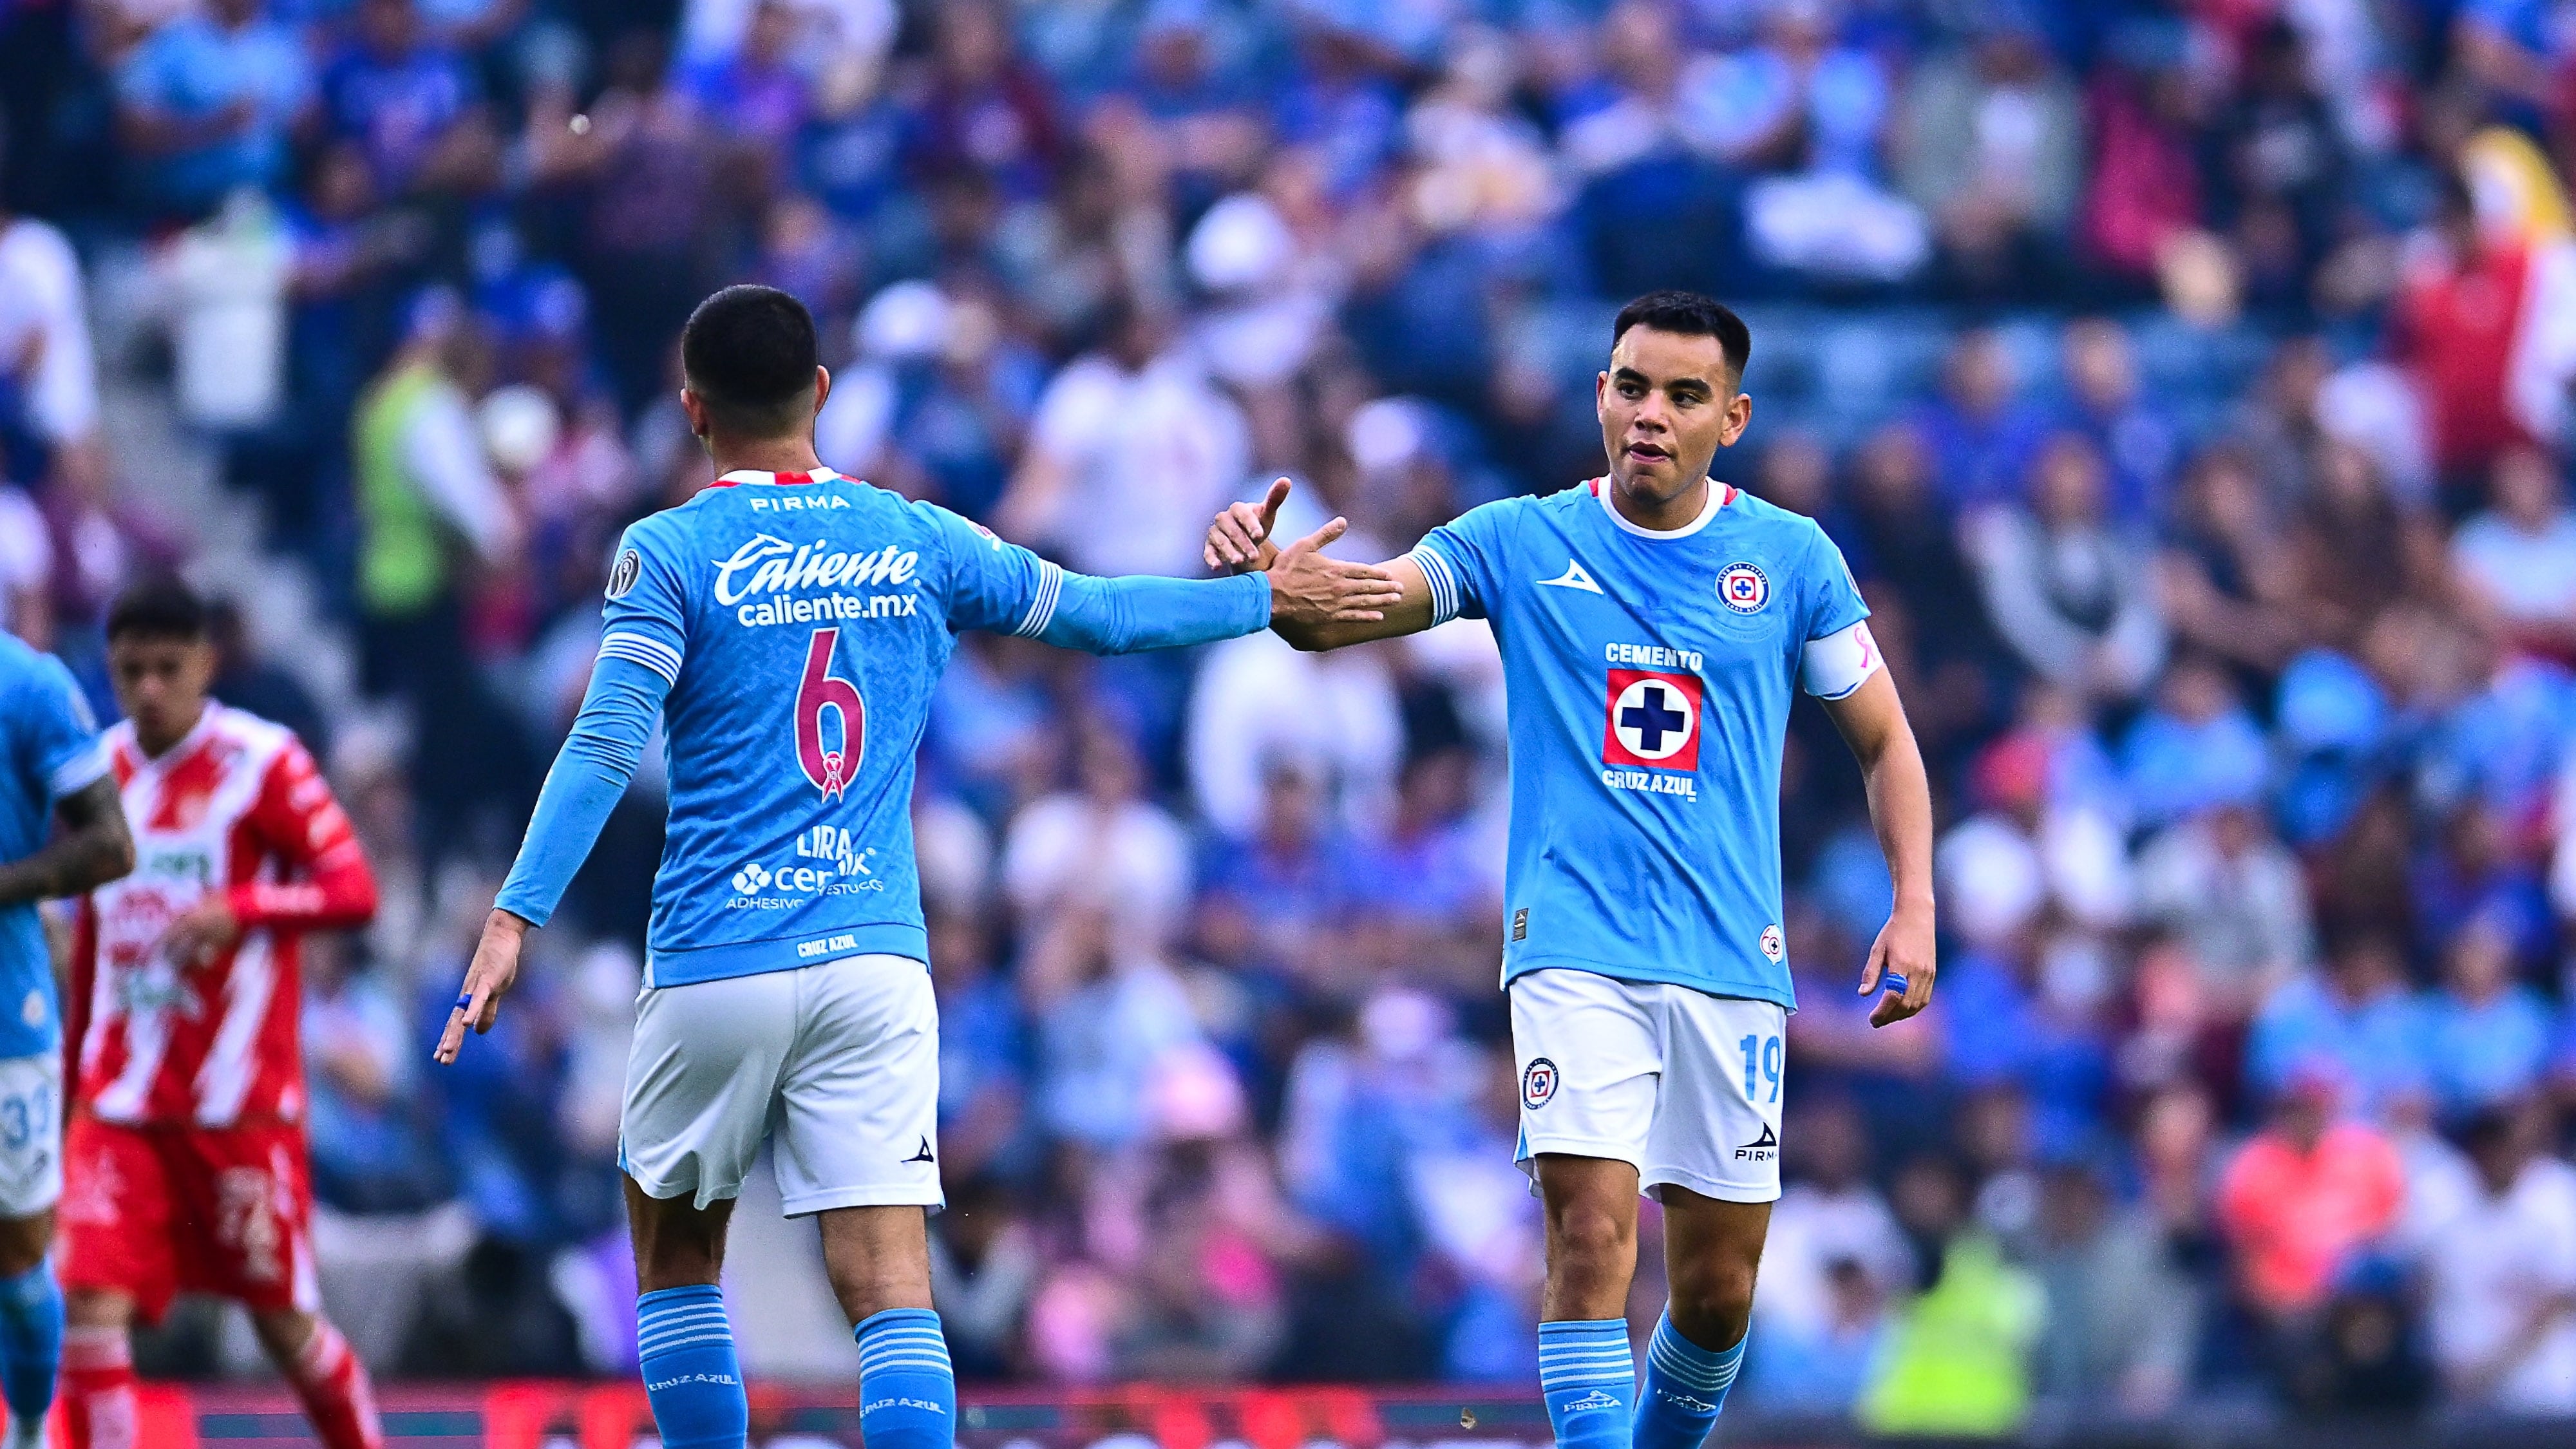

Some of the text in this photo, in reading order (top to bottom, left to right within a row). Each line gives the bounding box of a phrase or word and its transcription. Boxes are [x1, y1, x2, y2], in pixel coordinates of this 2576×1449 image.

[750, 495, 851, 512] PIRMA
[710, 533, 919, 606] Caliente
[737, 592, 918, 627] caliente.mx
[1605, 643, 1703, 672] CEMENTO
[794, 627, 866, 793] 6
[1602, 770, 1697, 797] CRUZ AZUL
[797, 825, 852, 860] LIRA
[797, 934, 858, 958] CRUZ AZUL
[1740, 1035, 1781, 1103] 19
[1735, 1150, 1777, 1162] PIRM
[648, 1373, 738, 1392] CRUZ AZUL
[897, 1397, 946, 1415] AZUL
